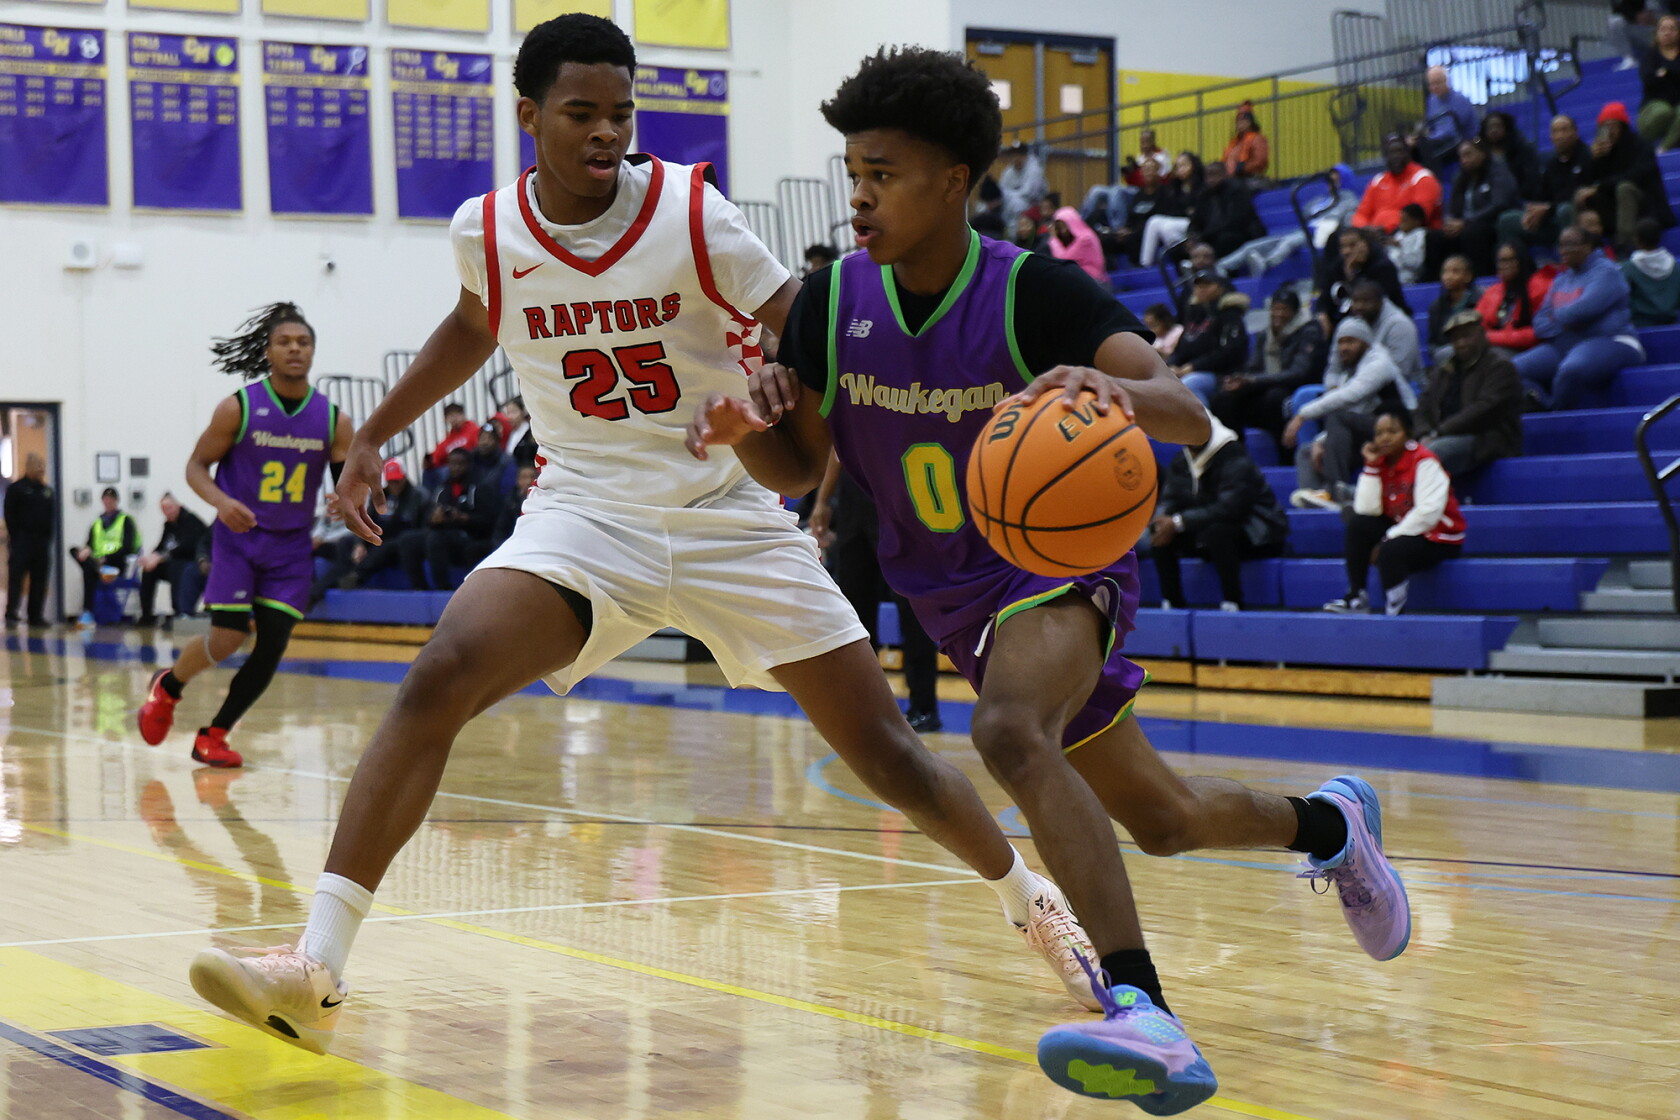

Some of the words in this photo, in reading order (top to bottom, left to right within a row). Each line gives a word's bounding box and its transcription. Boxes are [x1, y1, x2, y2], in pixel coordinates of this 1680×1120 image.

[133, 51, 180, 66] SOFTBALL
[523, 292, 681, 340] RAPTORS
[561, 340, 682, 422] 25
[839, 372, 1010, 423] Waukegan
[252, 431, 324, 454] Waukegan
[259, 460, 308, 504] 24
[901, 442, 966, 533] 0
